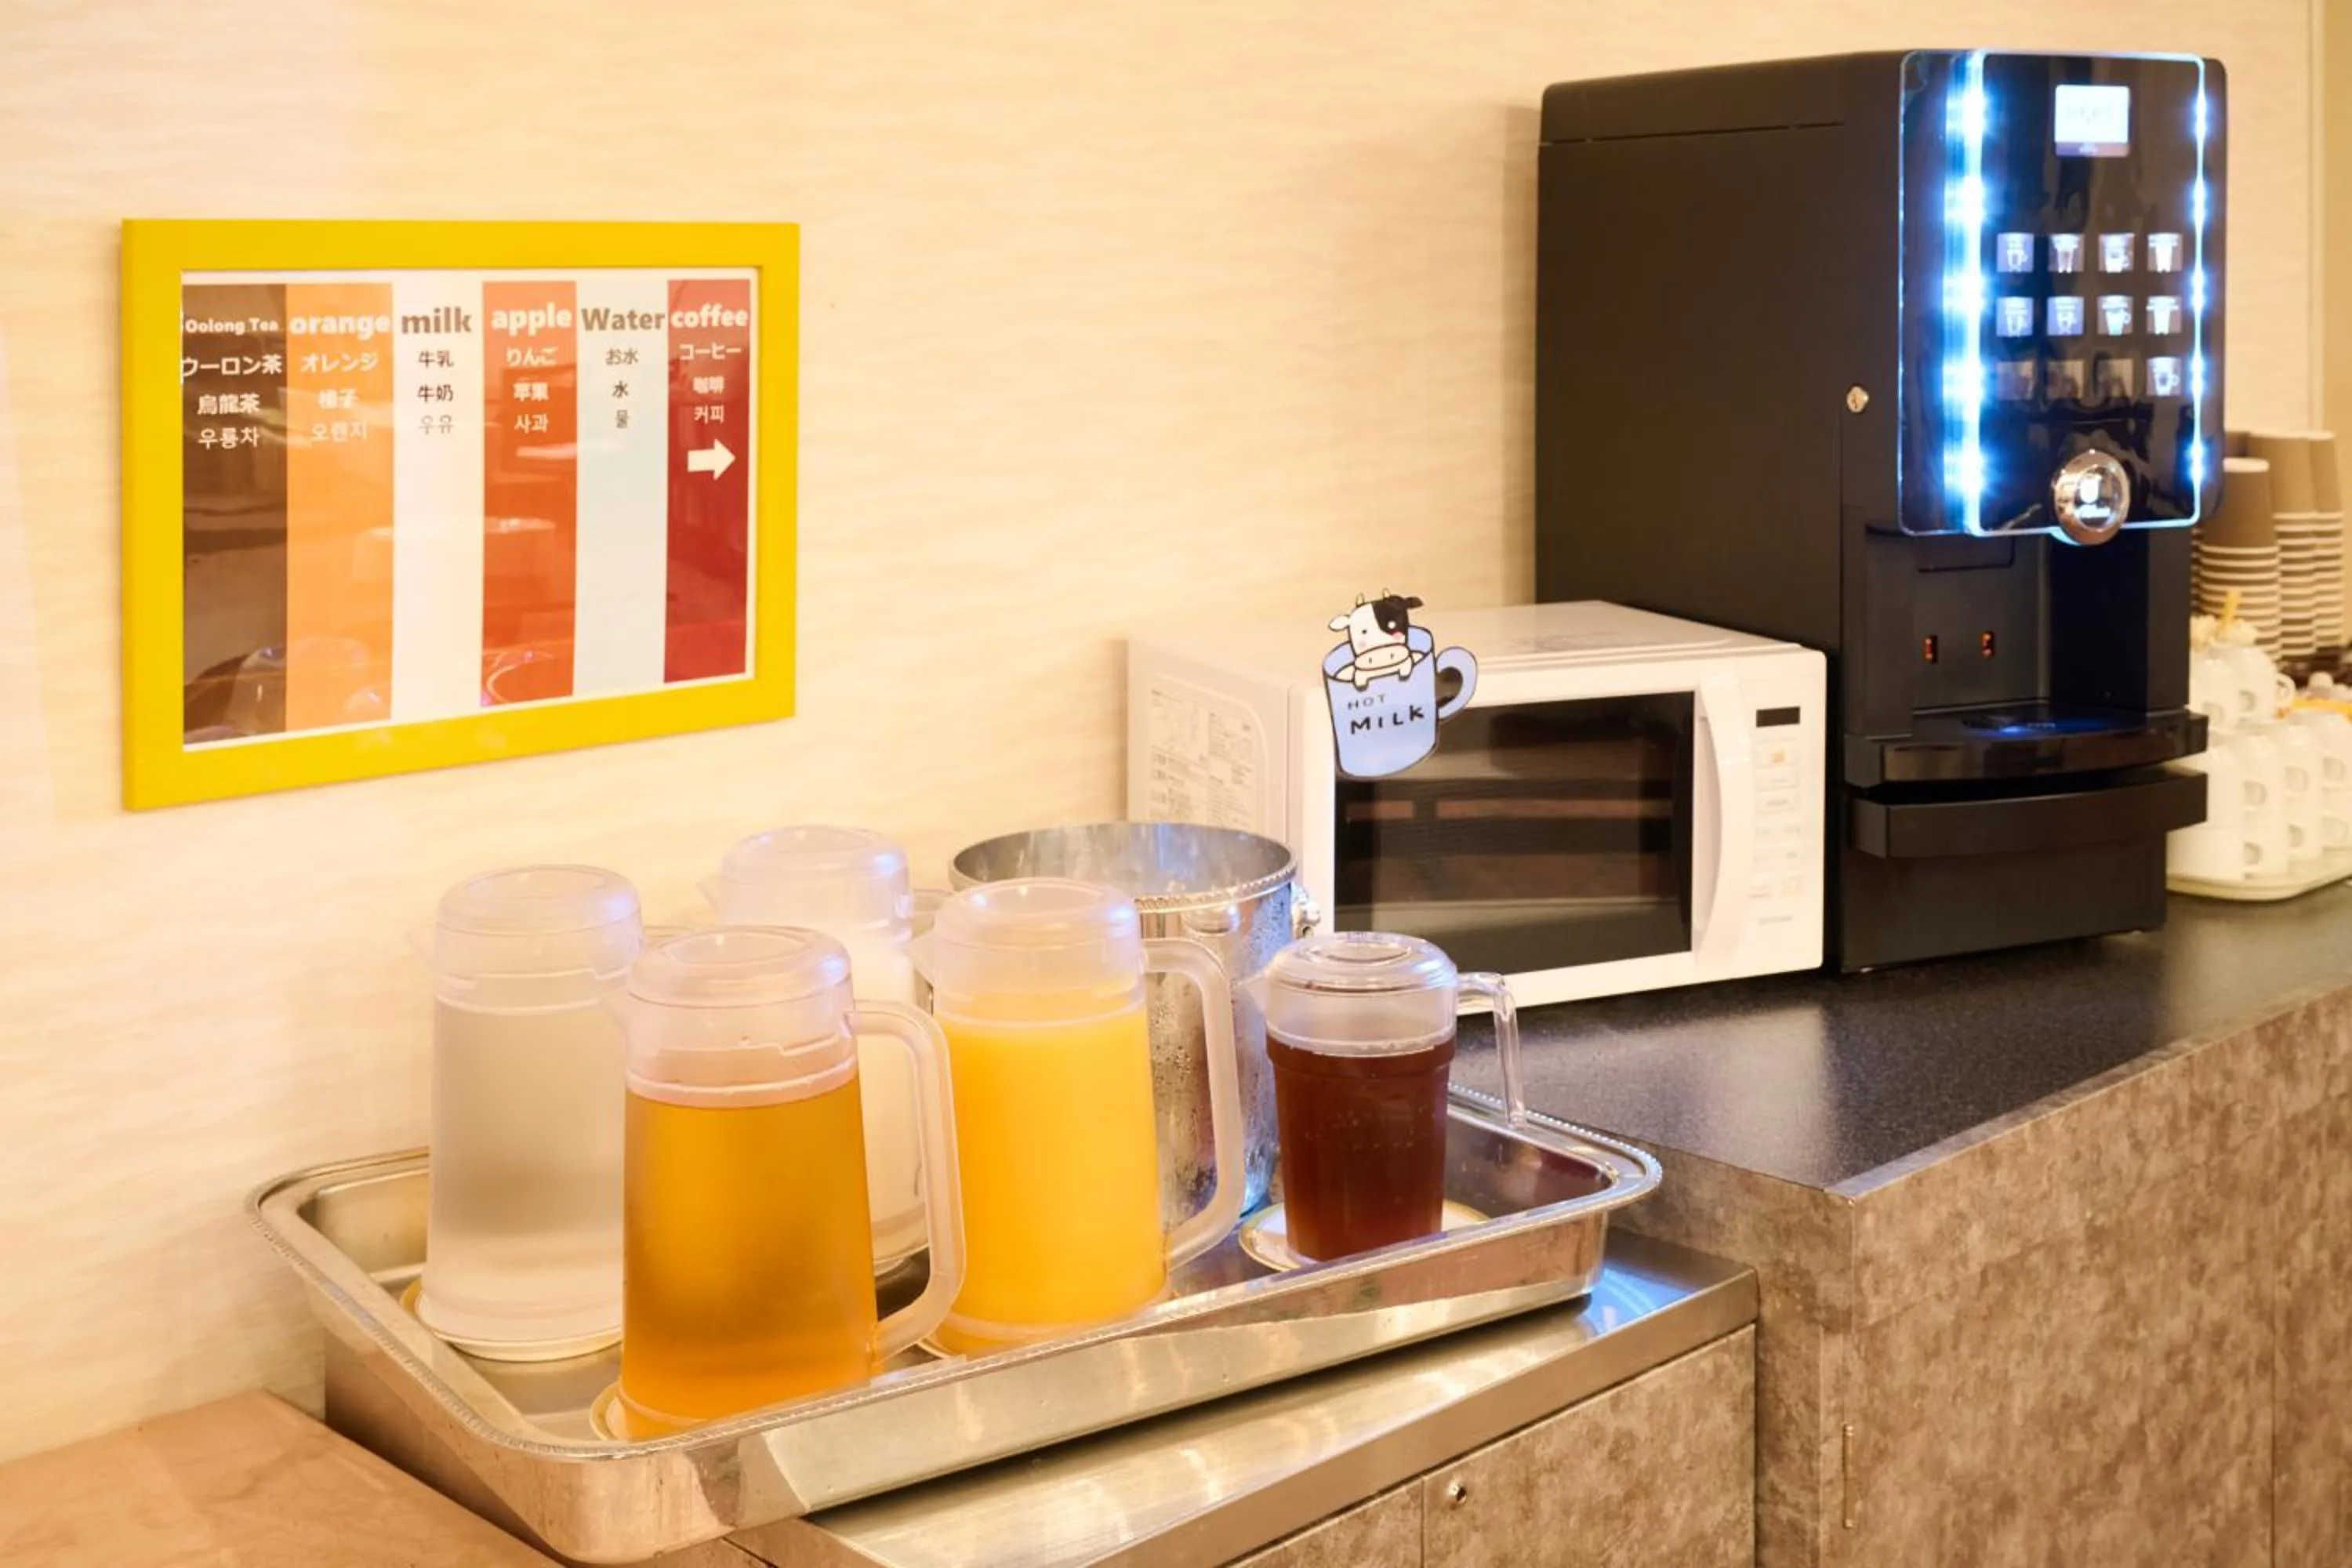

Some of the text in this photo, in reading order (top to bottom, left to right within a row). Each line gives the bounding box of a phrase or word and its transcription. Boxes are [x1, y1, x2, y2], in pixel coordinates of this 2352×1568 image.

[401, 306, 472, 334] milk
[492, 303, 572, 336] apple
[581, 308, 665, 332] Water
[671, 303, 748, 328] coffee
[185, 318, 279, 336] Oolong Tea
[289, 314, 390, 341] orange
[418, 350, 455, 368] 牛乳
[506, 347, 558, 367] りんご
[605, 347, 639, 365] お水
[680, 343, 742, 361] コーヒー
[182, 354, 283, 377] ウーロン茶
[300, 353, 379, 372] オレンジ
[417, 383, 454, 402] 牛奶
[612, 380, 630, 398] 水
[418, 414, 455, 435] 우유
[514, 413, 550, 434] 사과
[693, 405, 724, 424] 커피
[1348, 694, 1385, 710] HOT
[1351, 705, 1424, 735] MILK
